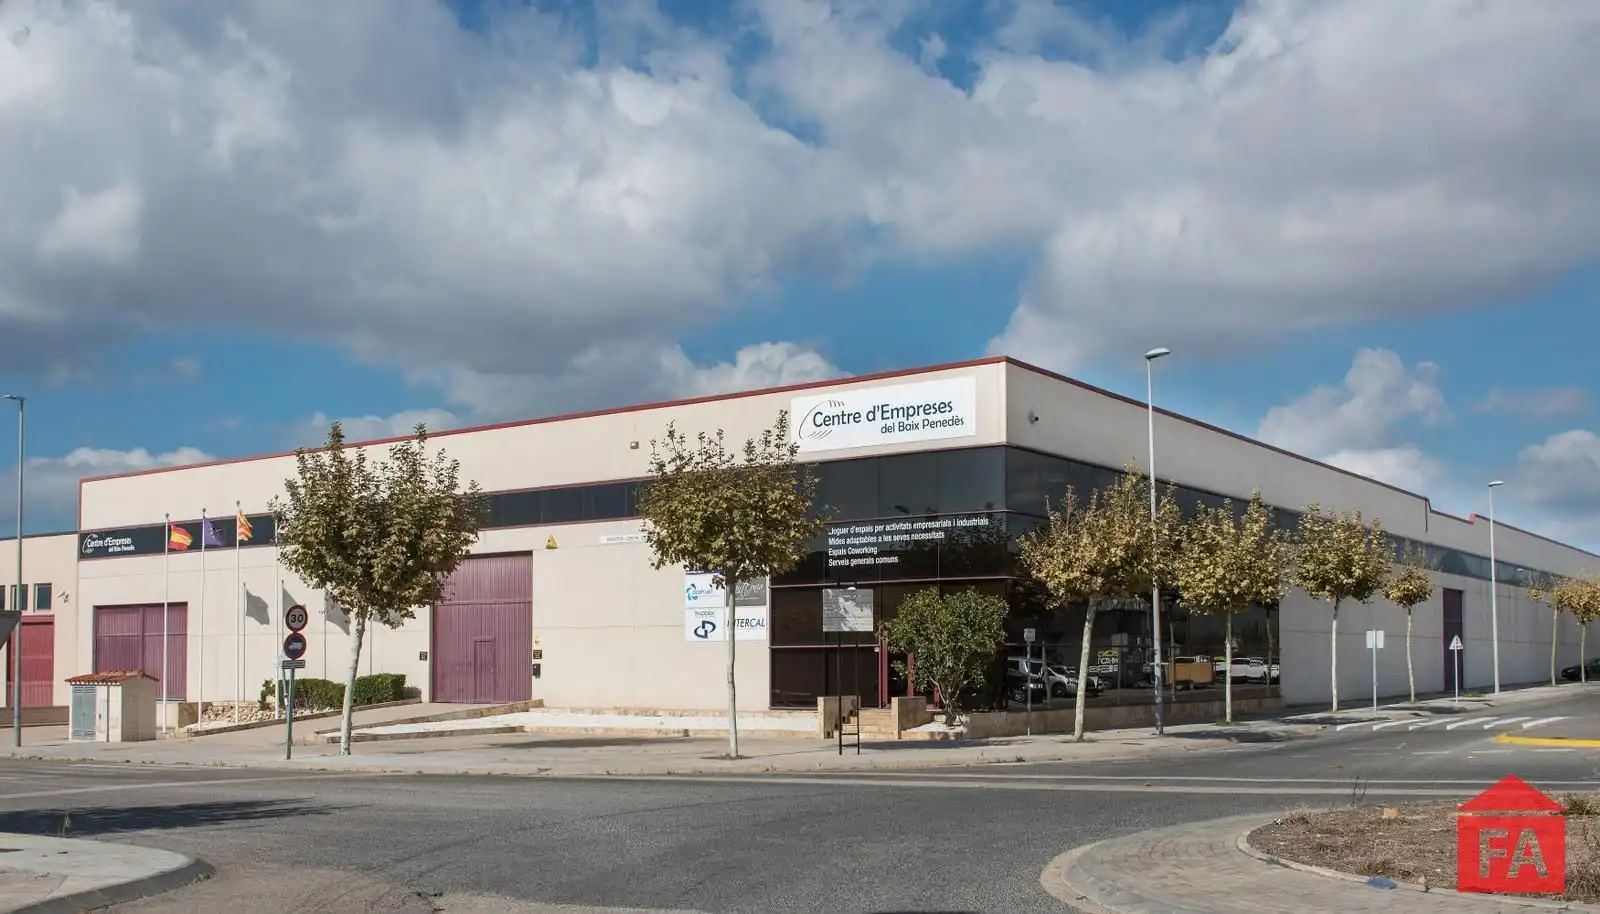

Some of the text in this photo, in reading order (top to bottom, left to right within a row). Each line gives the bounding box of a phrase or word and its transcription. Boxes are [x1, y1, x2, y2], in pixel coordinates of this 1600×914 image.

[813, 400, 953, 427] Centre d'Empreses
[881, 415, 964, 434] del Baix Penedès
[875, 525, 884, 533] per
[885, 522, 912, 530] activitats
[913, 519, 952, 530] empresarials
[957, 517, 988, 526] industrials
[87, 538, 103, 548] Centre
[829, 537, 845, 545] Mides
[846, 535, 877, 545] adaptables
[911, 531, 945, 540] necessitats
[829, 546, 877, 556] Espais Coworking
[829, 556, 898, 566] Serveis generals comuns
[291, 614, 303, 623] 30
[727, 618, 765, 628] ITERCAL
